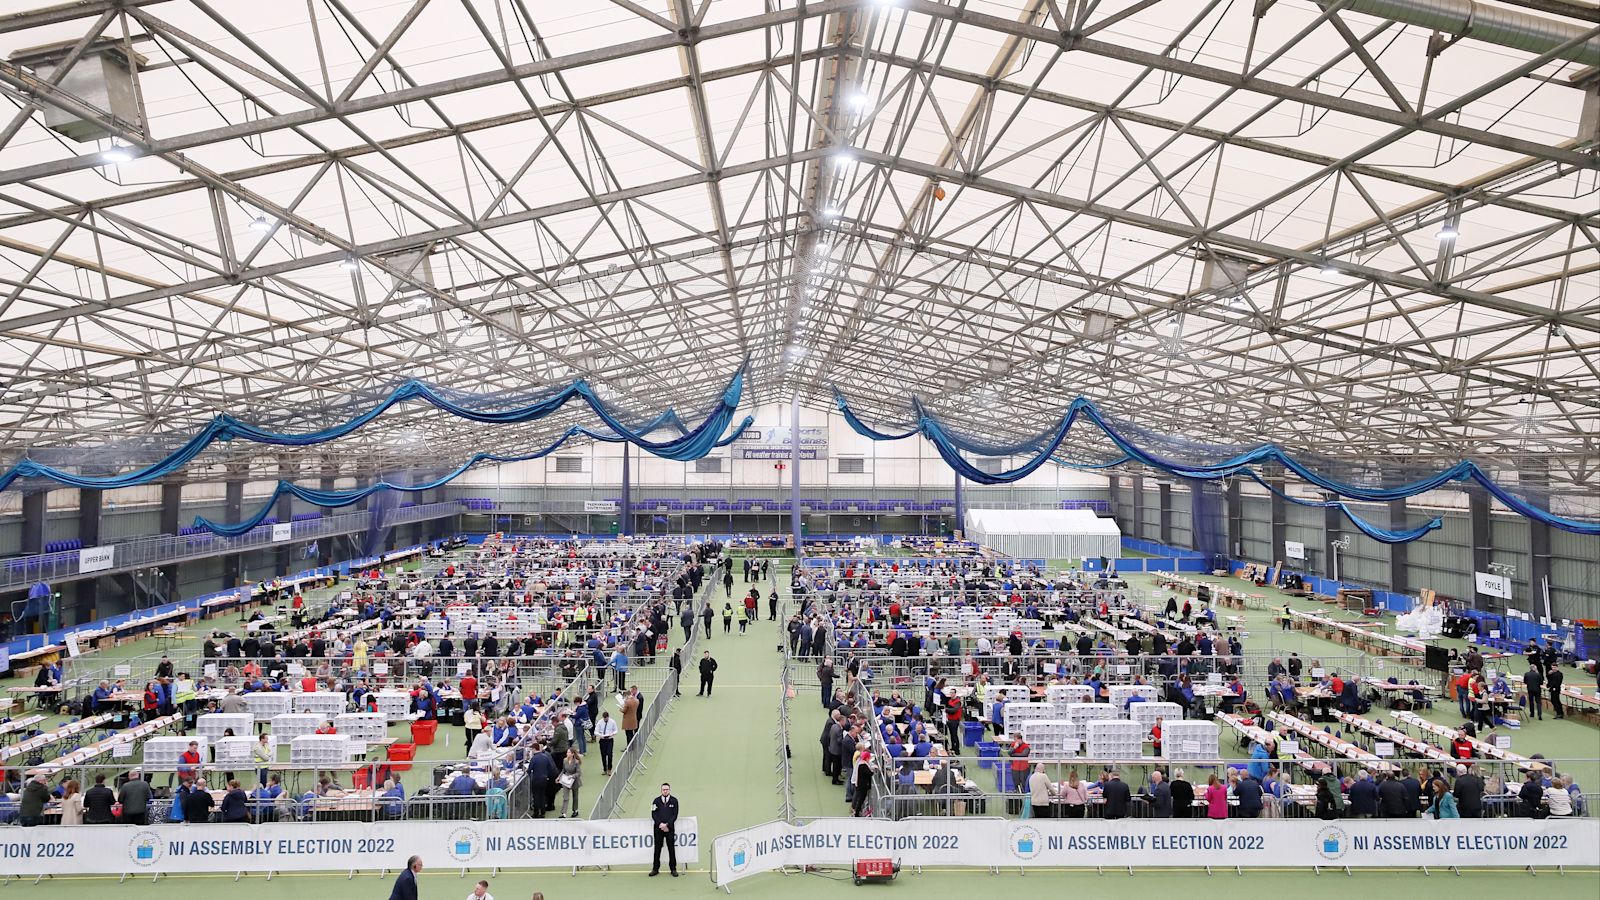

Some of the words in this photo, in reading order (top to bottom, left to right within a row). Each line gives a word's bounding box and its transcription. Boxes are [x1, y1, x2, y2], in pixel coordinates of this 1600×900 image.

[84, 556, 99, 564] UPPER
[99, 554, 110, 562] BANN
[1484, 580, 1501, 590] FOYLE
[36, 842, 75, 858] 2022
[168, 841, 185, 856] NI
[189, 839, 272, 856] ASSEMBLY
[278, 838, 352, 855] ELECTION
[357, 838, 395, 853] 2022
[486, 836, 501, 852] NI
[505, 834, 587, 851] ASSEMBLY
[592, 834, 655, 850] ELECTIO
[756, 841, 768, 857] NI
[770, 834, 842, 852] ASSEMBLY
[847, 834, 918, 851] ELECTION
[922, 835, 959, 850] 2022
[1048, 835, 1063, 850] NI
[1067, 835, 1147, 850] ASSEMBLY
[1152, 835, 1224, 850] ELECTION
[1228, 835, 1265, 850] 2022
[1353, 835, 1369, 851] NI
[1373, 835, 1451, 851] ASSEMBLY
[1456, 835, 1529, 851] ELECTION
[1533, 834, 1568, 850] 2022
